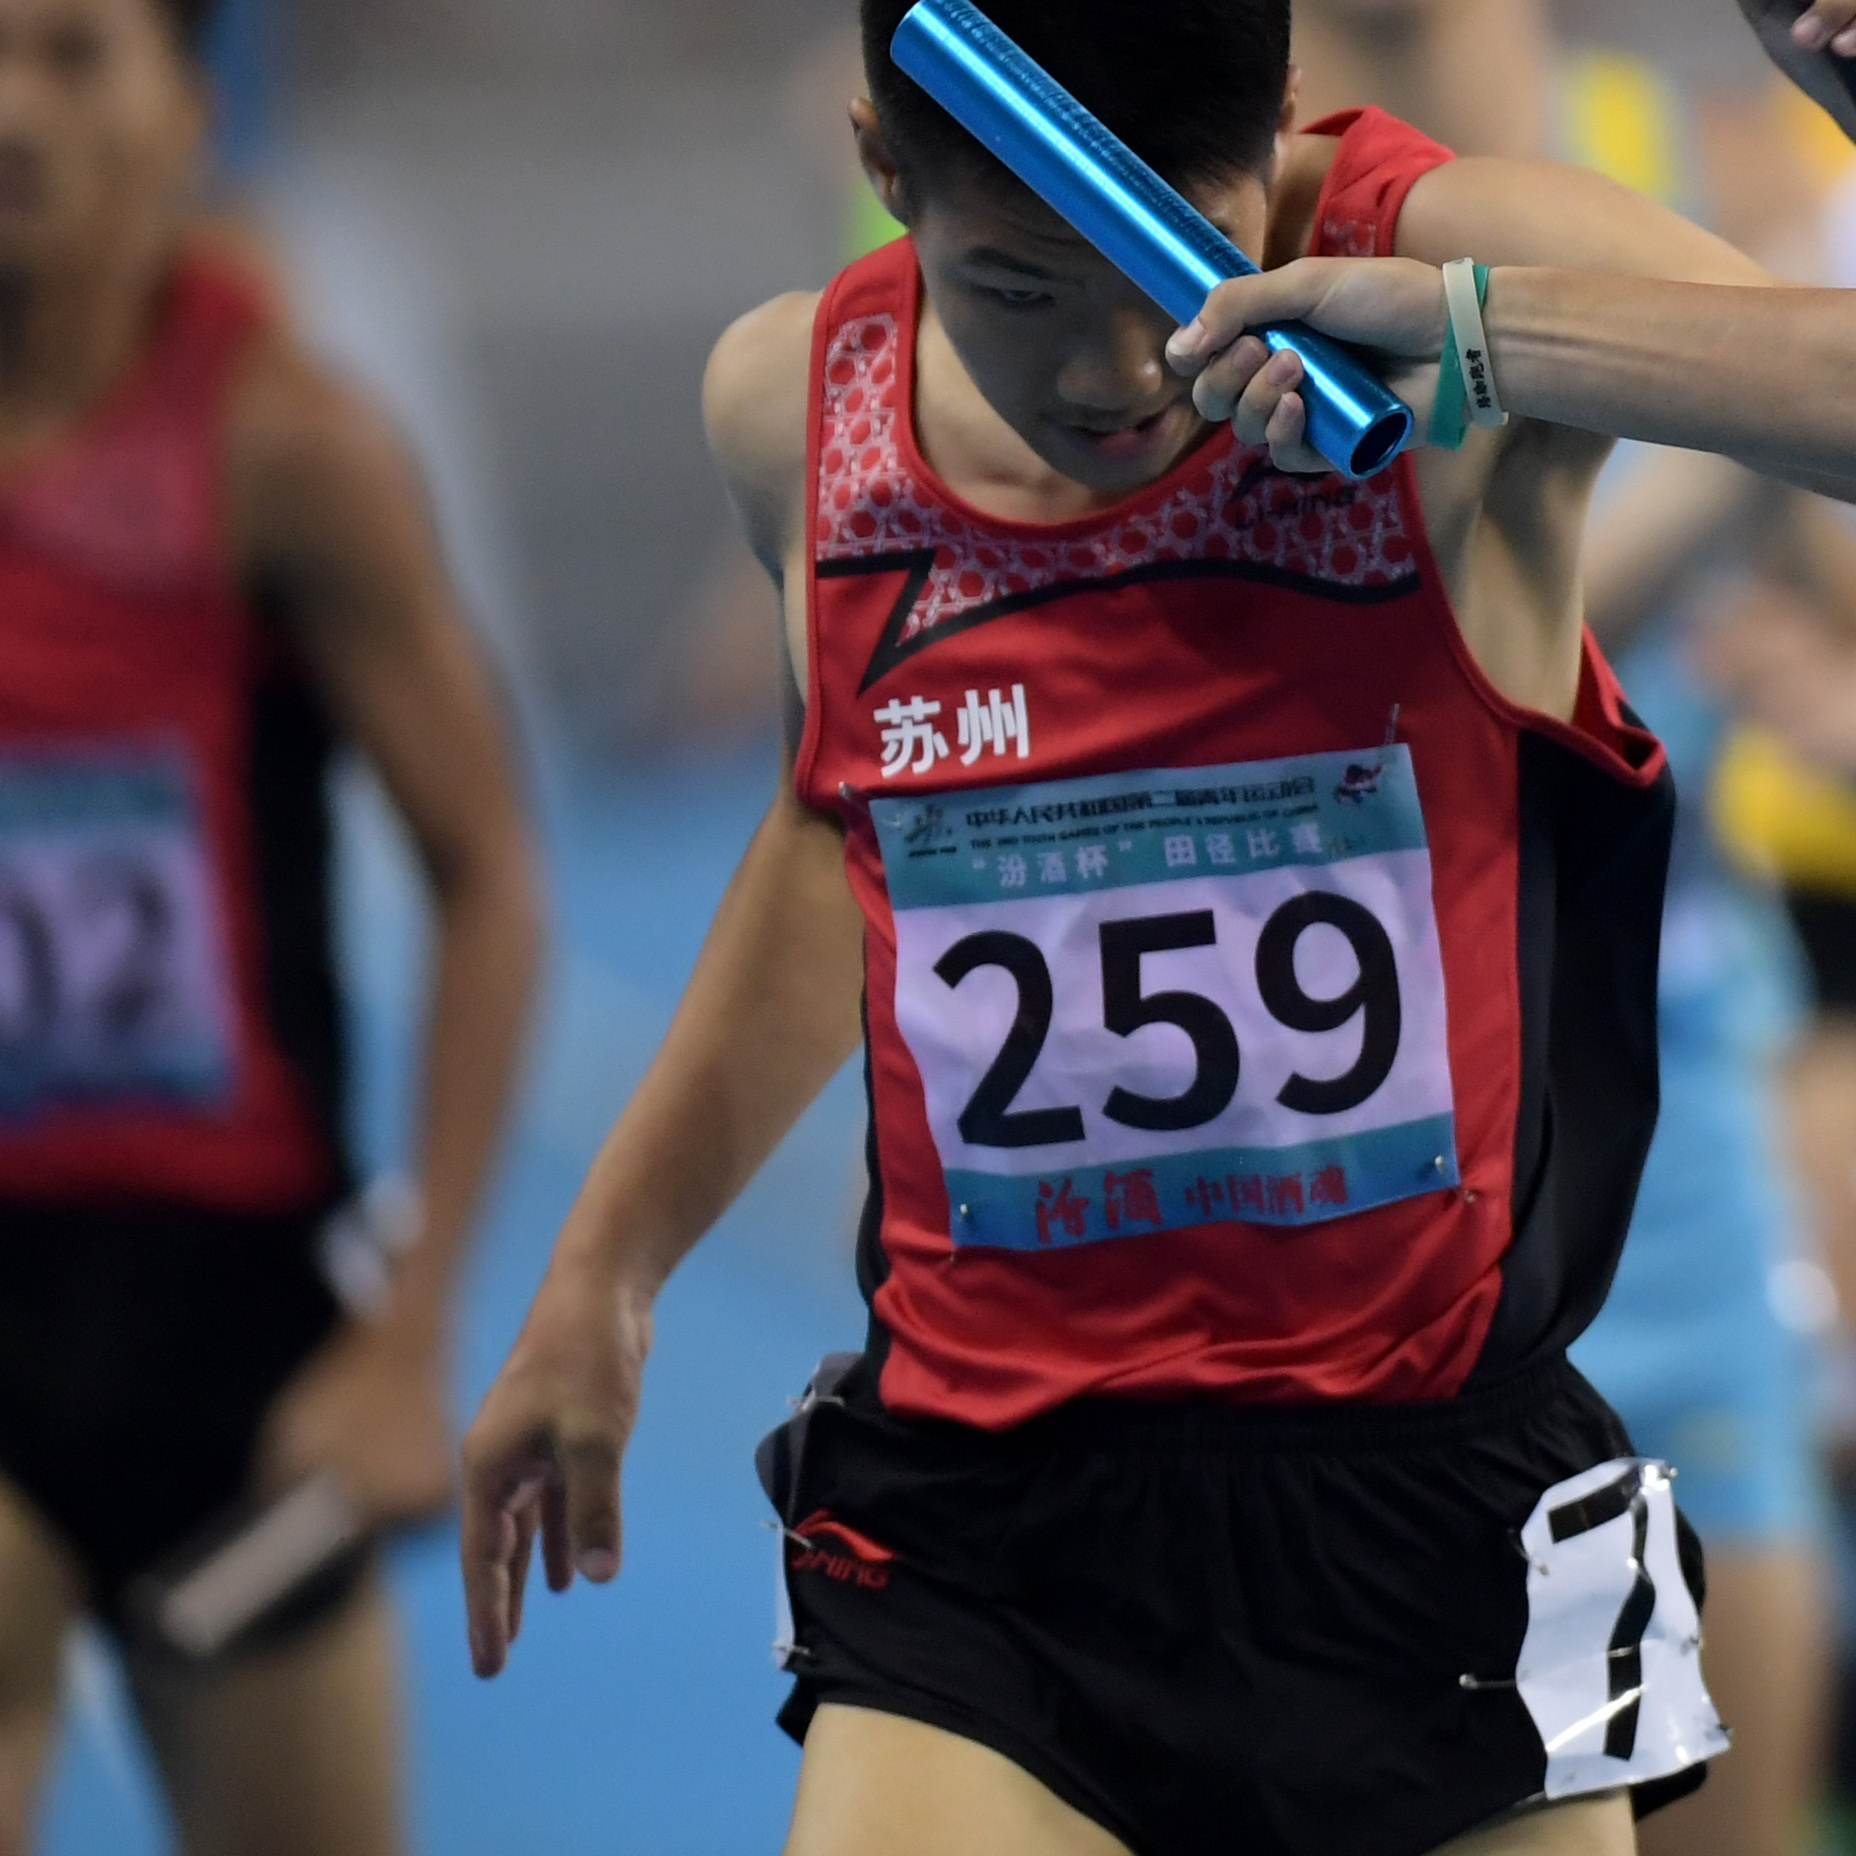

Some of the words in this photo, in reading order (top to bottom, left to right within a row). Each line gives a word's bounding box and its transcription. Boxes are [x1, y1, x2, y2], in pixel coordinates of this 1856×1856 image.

[872, 683, 1030, 778] 苏州
[932, 889, 1402, 1149] 259
[1545, 1462, 1656, 1760] 7
